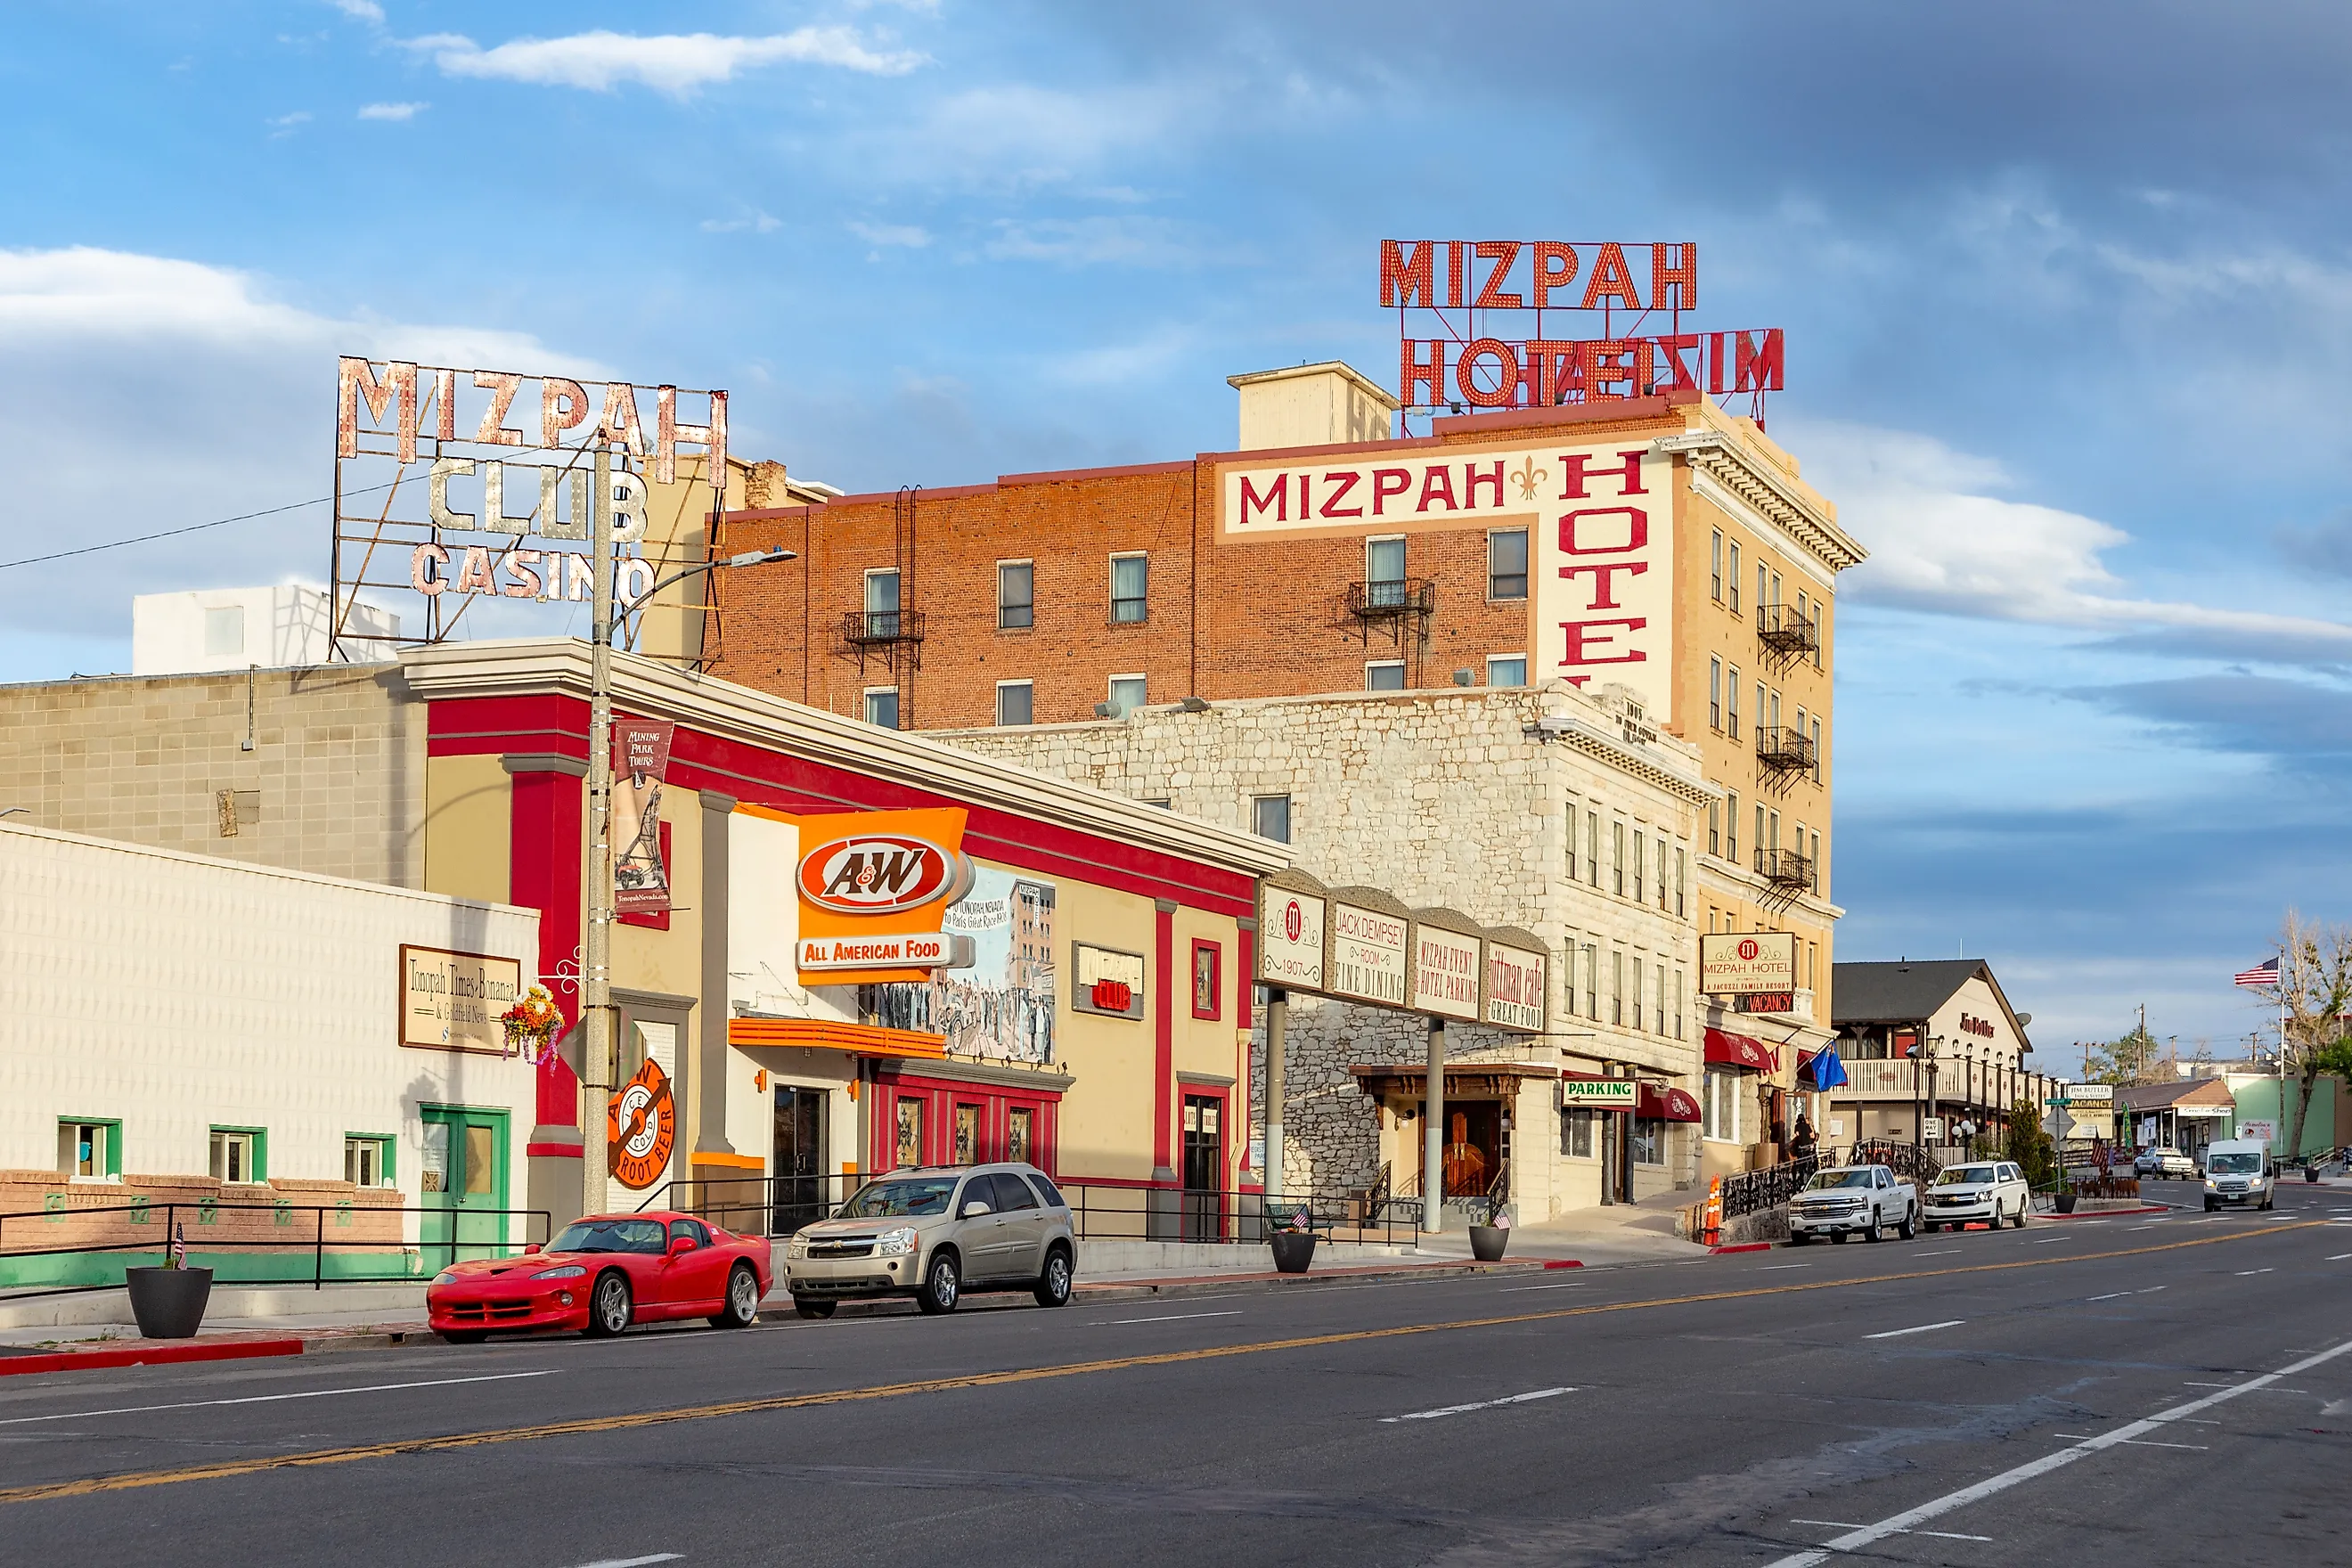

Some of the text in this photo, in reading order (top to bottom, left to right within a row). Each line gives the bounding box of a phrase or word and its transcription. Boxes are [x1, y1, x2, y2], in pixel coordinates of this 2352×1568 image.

[1380, 240, 1696, 309] MIZPAH
[1401, 339, 1654, 407] HOTEL
[339, 355, 729, 489] MIZPAH
[429, 457, 648, 543] CLUB
[1239, 460, 1506, 524] MIZPAH
[411, 542, 656, 611] CASINO
[1558, 449, 1650, 690] HOTE
[627, 731, 660, 743] MINING
[631, 743, 654, 755] PARK
[628, 755, 654, 767] TOURS
[822, 848, 927, 894] A&W
[1020, 885, 1040, 897] MIZPAH
[952, 913, 967, 929] Paris
[968, 915, 983, 929] Great
[983, 915, 997, 929] Race
[1335, 912, 1405, 947] JACK DEMPSEY
[1283, 959, 1303, 977] 1907
[1360, 948, 1380, 966] ROOM
[1420, 940, 1473, 976] MIZPAH EVENT
[1704, 962, 1792, 974] MIZPAH HOTEL
[409, 958, 515, 1003] Tonopah Times-Bonanza
[1335, 961, 1402, 1001] FINE DINING
[1420, 969, 1443, 998] HOTEL
[1445, 975, 1477, 1004] PARKING
[1488, 950, 1542, 1008] pittman cafe
[1713, 983, 1739, 991] JACUZZI
[1765, 982, 1790, 990] RESORT
[1092, 980, 1131, 1012] CLUB
[1735, 994, 1792, 1013] NO VACANCY
[436, 1001, 487, 1025] & Goldfield News
[1490, 1000, 1541, 1029] GREAT FOOD
[1567, 1082, 1632, 1096] PARKING
[2070, 1086, 2110, 1094] JIM BUTLER
[625, 1095, 643, 1118] ICE
[620, 1108, 673, 1182] ROOT BEER
[633, 1120, 654, 1149] COLD
